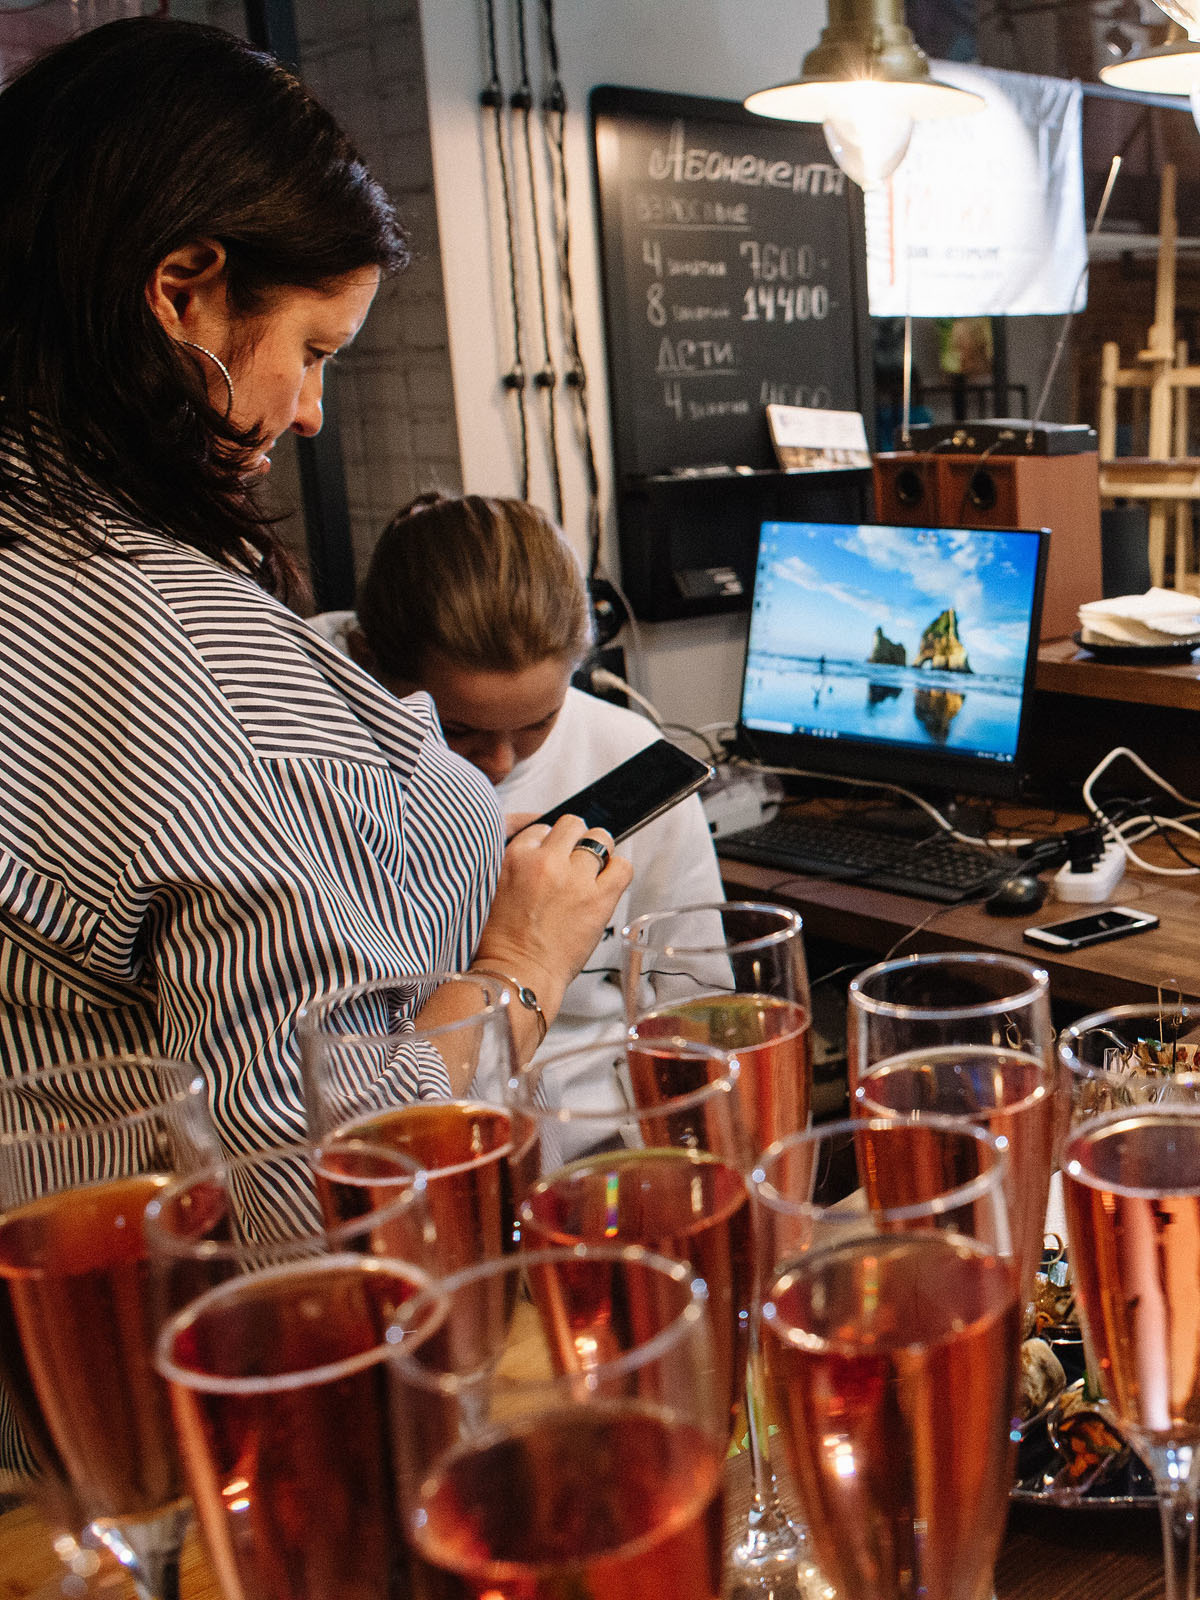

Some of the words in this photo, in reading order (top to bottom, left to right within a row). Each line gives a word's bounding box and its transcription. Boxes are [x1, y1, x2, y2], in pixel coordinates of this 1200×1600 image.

[642, 238, 664, 278] 4
[646, 282, 668, 328] 8
[663, 379, 683, 422] 4
